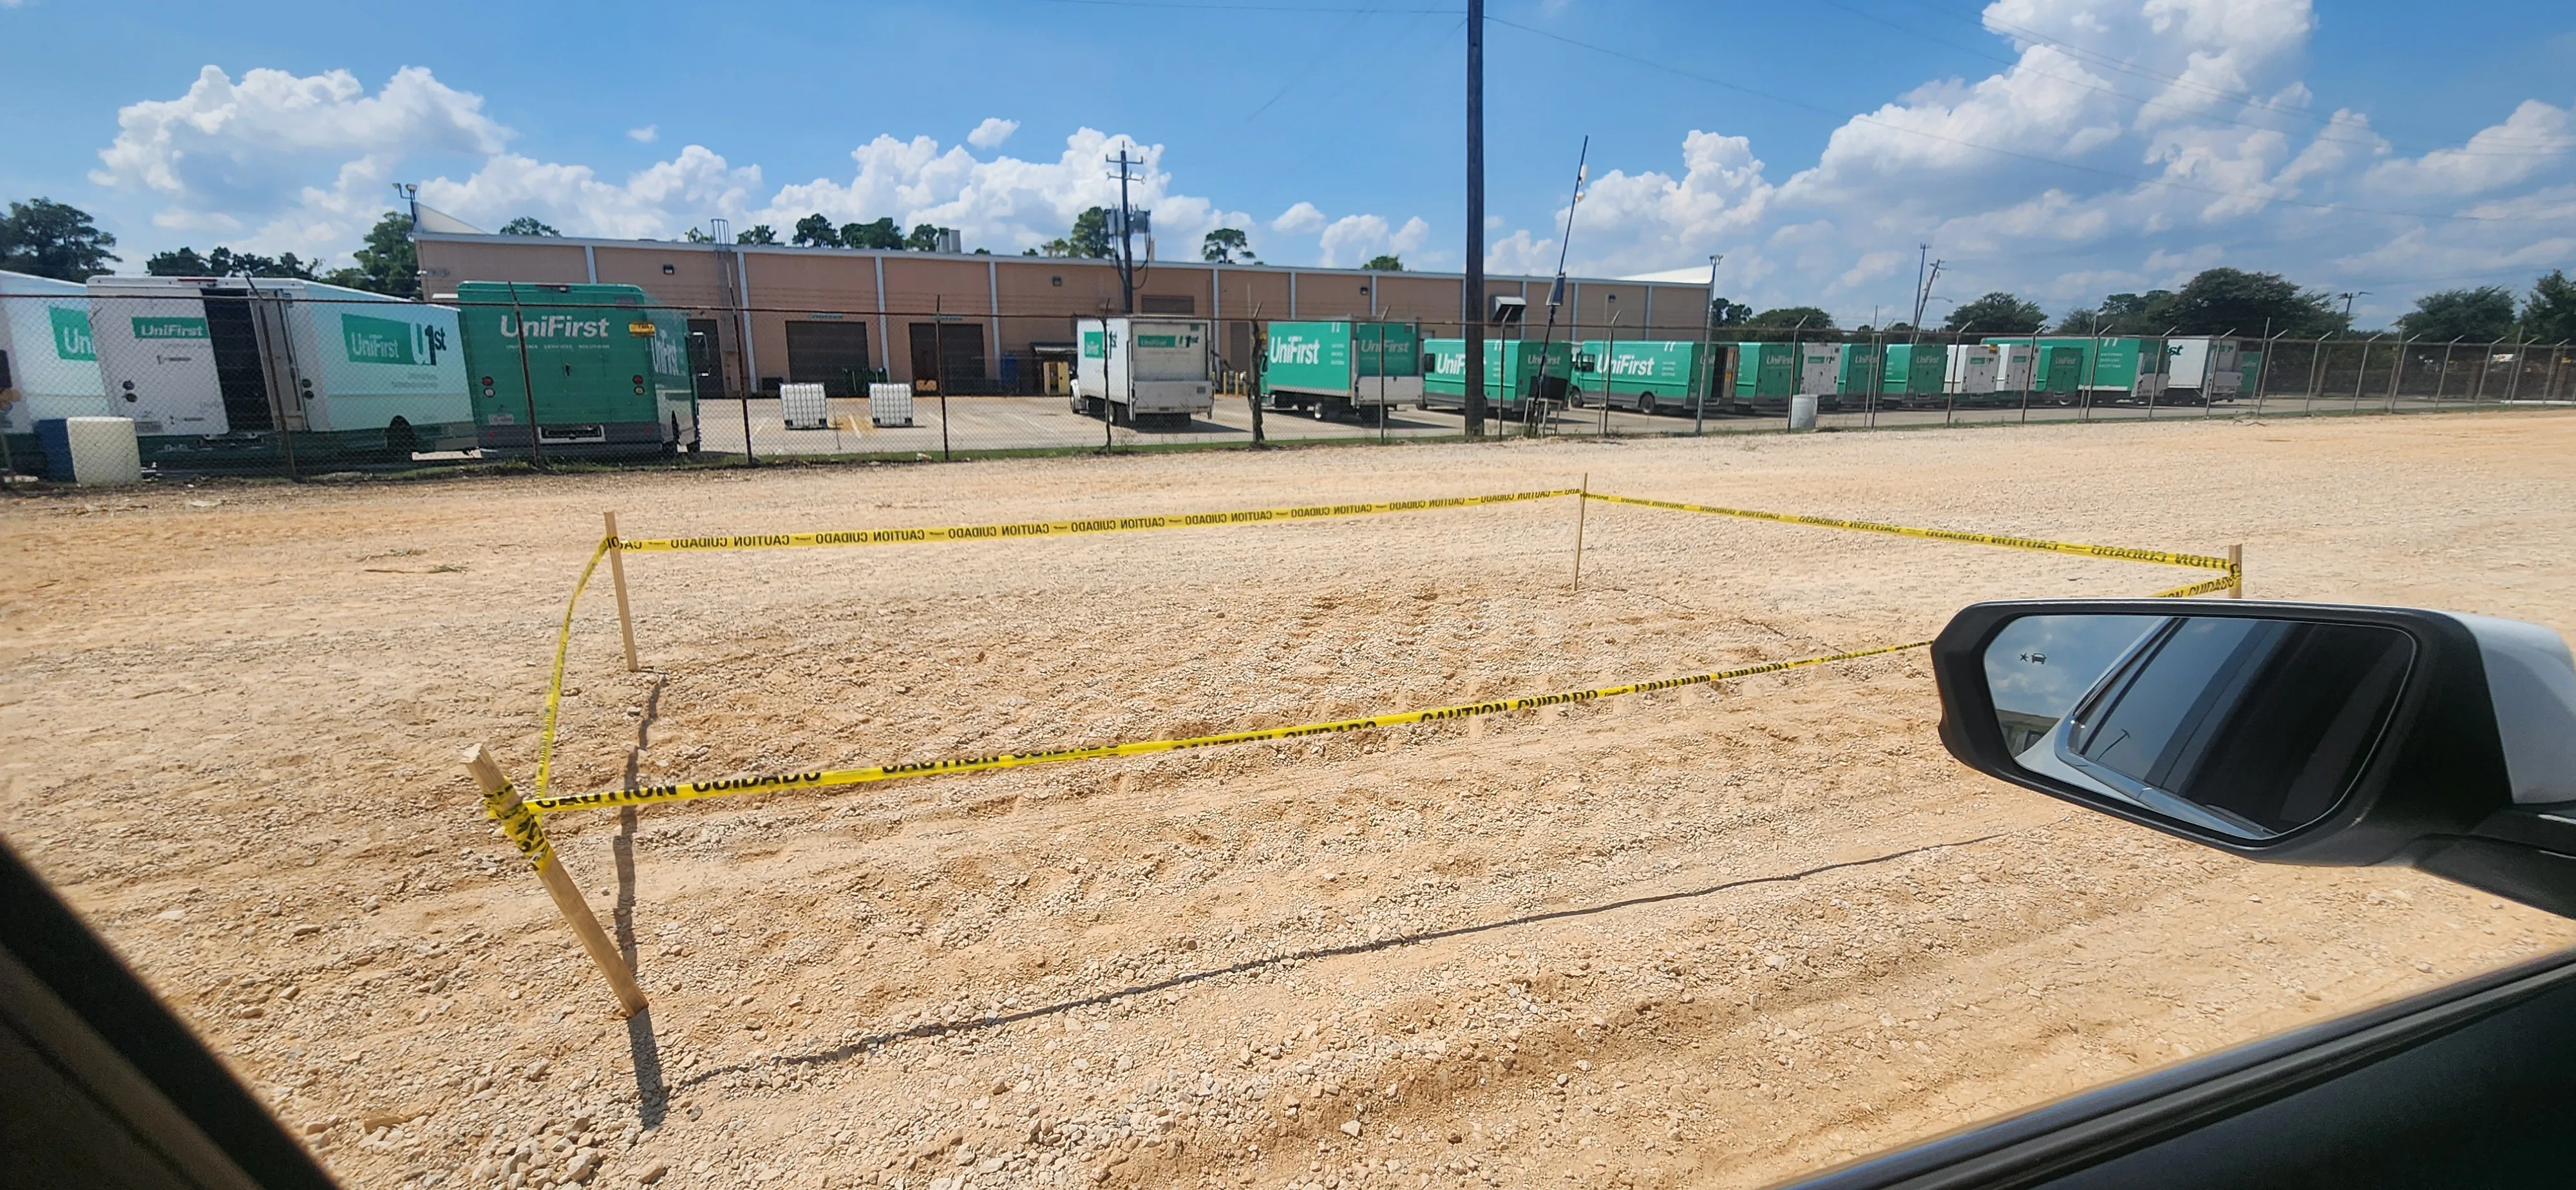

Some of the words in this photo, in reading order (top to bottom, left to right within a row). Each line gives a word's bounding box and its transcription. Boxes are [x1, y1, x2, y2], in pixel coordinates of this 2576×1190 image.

[140, 324, 204, 337] UniFirst
[501, 315, 610, 337] UniFirst
[352, 332, 399, 358] UniFirst
[1270, 335, 1320, 364] UniFirst
[1436, 353, 1465, 375] UniF
[1528, 355, 1560, 365] Uniirst
[1597, 354, 1654, 375] UniFirst
[1766, 355, 1792, 365] UniFirs
[1420, 702, 1508, 723] CAUTION
[1517, 689, 1598, 710] CUIDADO
